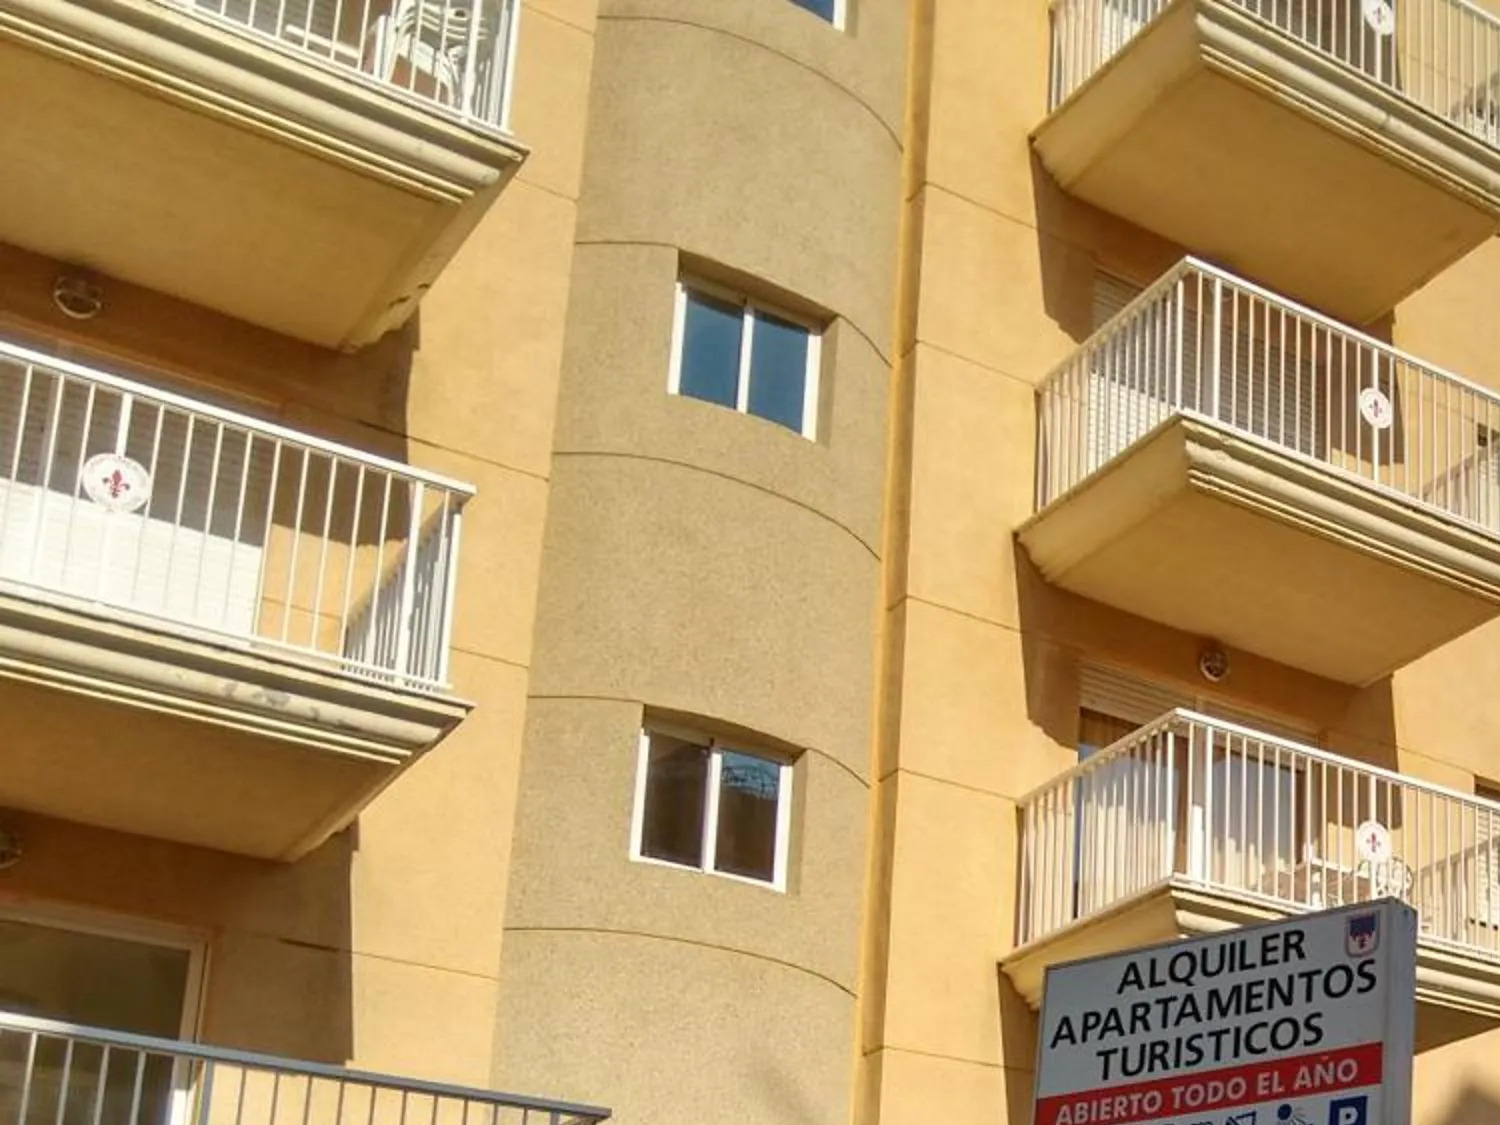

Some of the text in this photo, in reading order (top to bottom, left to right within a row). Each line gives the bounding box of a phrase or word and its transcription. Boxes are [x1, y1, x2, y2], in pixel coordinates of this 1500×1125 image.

[1116, 929, 1306, 995] ALQUILER
[1050, 959, 1378, 1049] APARTAMENTOS
[1097, 1012, 1325, 1081] TURISTICOS
[1171, 1076, 1248, 1110] TODO
[1256, 1069, 1285, 1097] EL
[1294, 1053, 1359, 1090] AÑO
